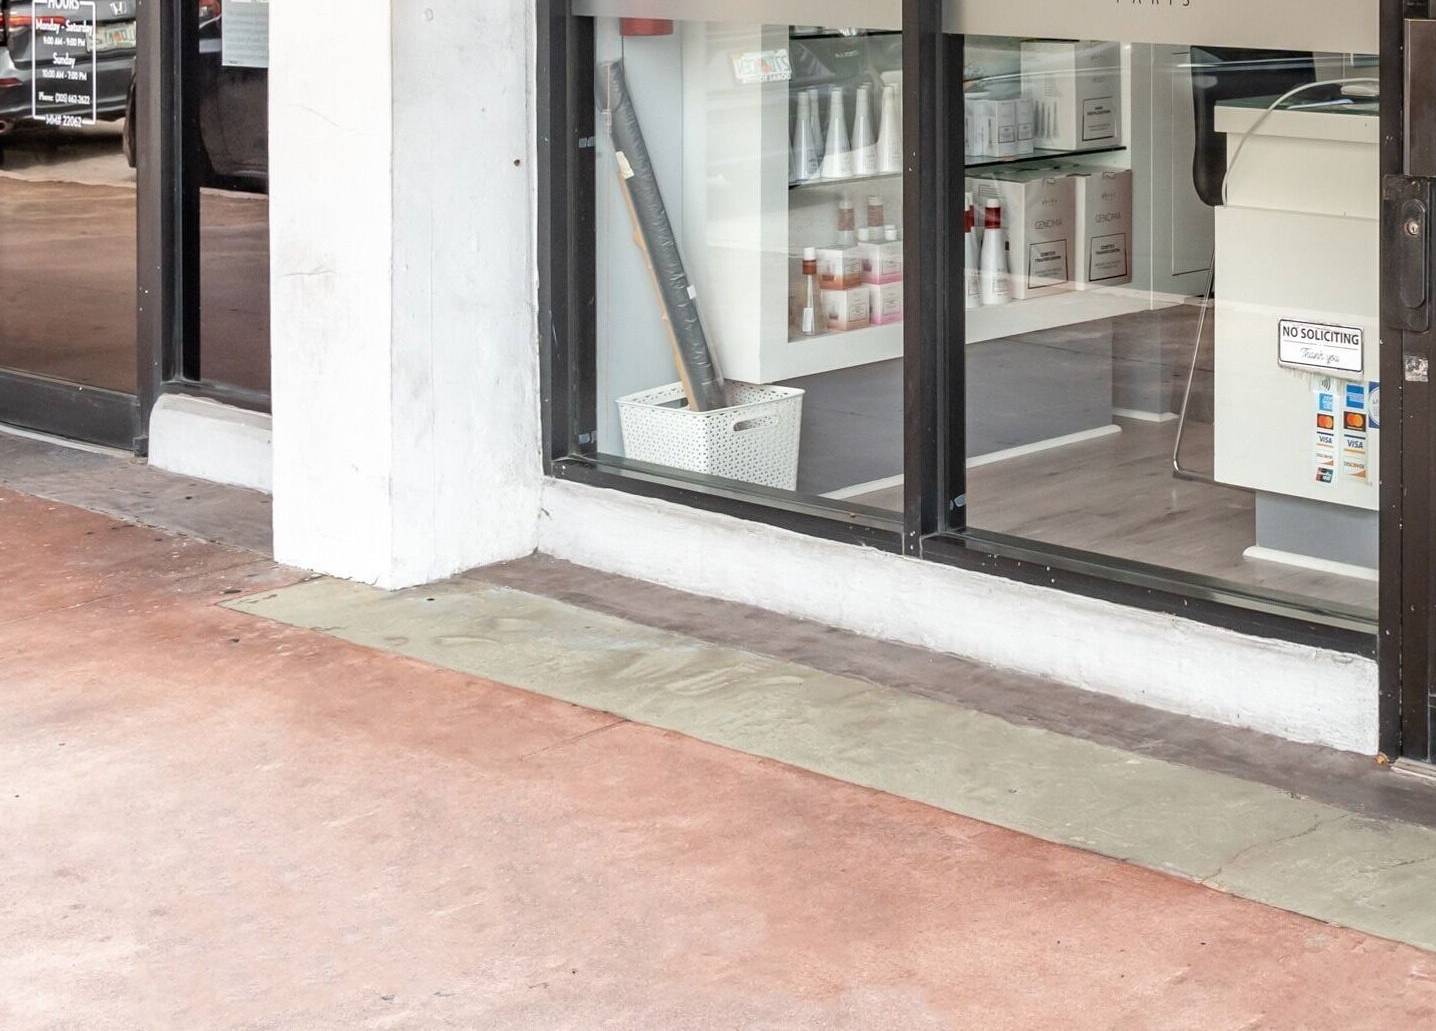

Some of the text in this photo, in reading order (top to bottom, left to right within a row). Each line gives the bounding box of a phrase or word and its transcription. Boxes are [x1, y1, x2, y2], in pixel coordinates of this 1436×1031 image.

[35, 18, 61, 34] Monday
[65, 19, 93, 35] Saturday
[52, 52, 76, 69] Sunday
[1282, 325, 1360, 346] NO SOLICITING
[1319, 436, 1333, 444] VISA
[1347, 439, 1364, 449] VISA
